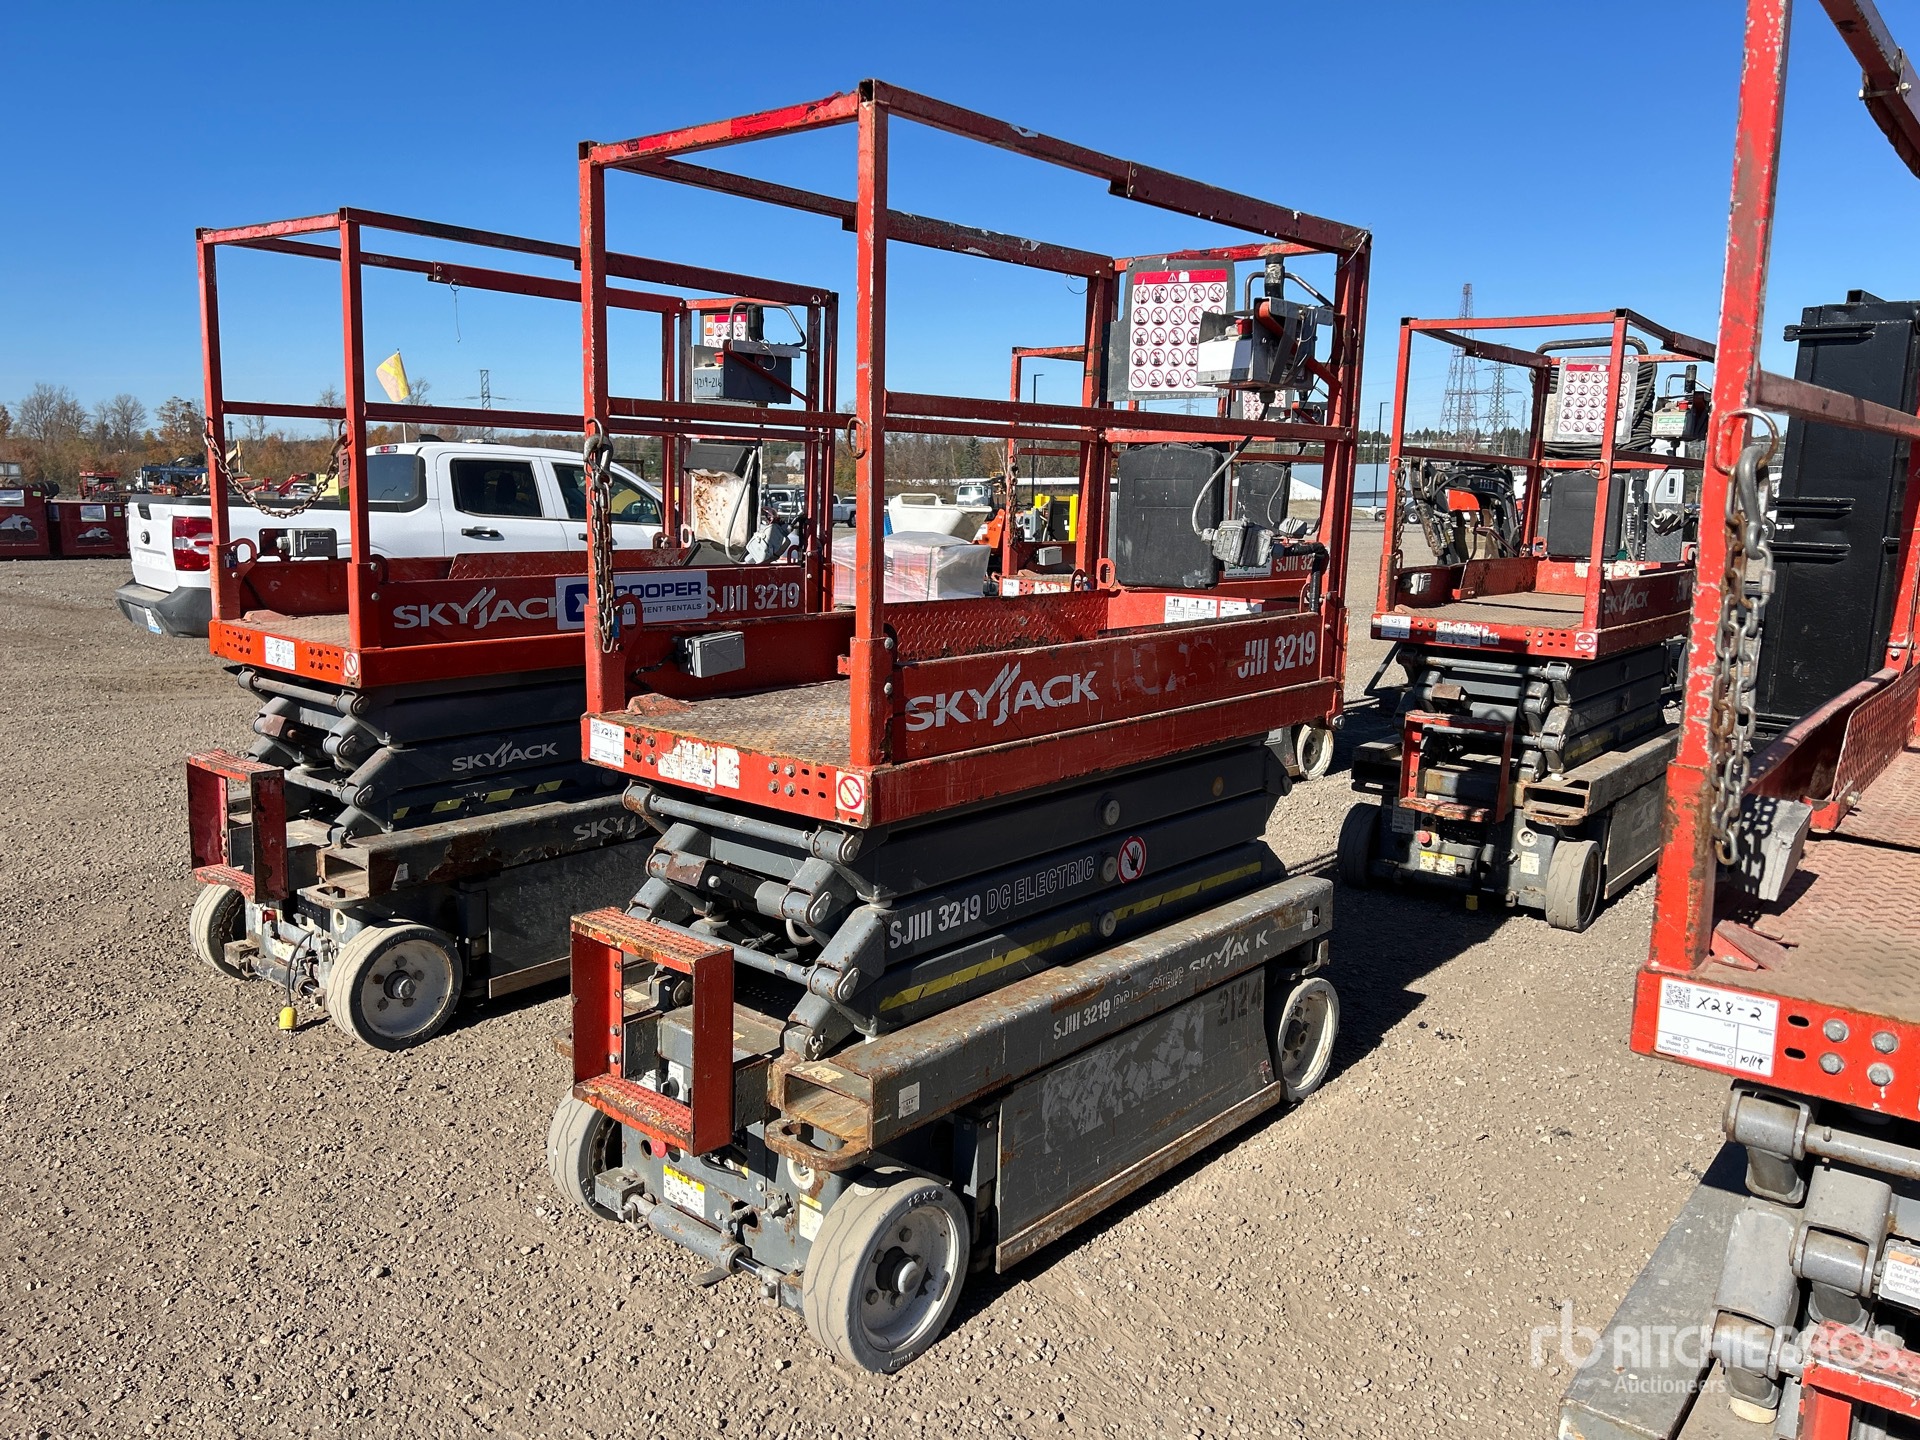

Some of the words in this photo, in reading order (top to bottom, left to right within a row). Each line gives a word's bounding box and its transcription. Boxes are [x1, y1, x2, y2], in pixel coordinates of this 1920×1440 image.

[665, 602, 702, 614] RENTALS
[753, 582, 799, 612] 3219
[1273, 630, 1316, 672] 3219
[904, 661, 1100, 732] SKYJACK
[452, 741, 559, 772] SKYJACK
[889, 909, 933, 950] SJIII
[938, 895, 981, 932] 3219
[986, 883, 1011, 916] DC
[1014, 855, 1095, 906] ELECTRIC
[1053, 1012, 1081, 1040] SJIII
[1083, 998, 1110, 1027] 3219
[1696, 996, 1762, 1021] X28-2
[1696, 1046, 1726, 1058] Inspection
[1892, 1263, 1902, 1271] DO
[1904, 1267, 1918, 1276] NOT
